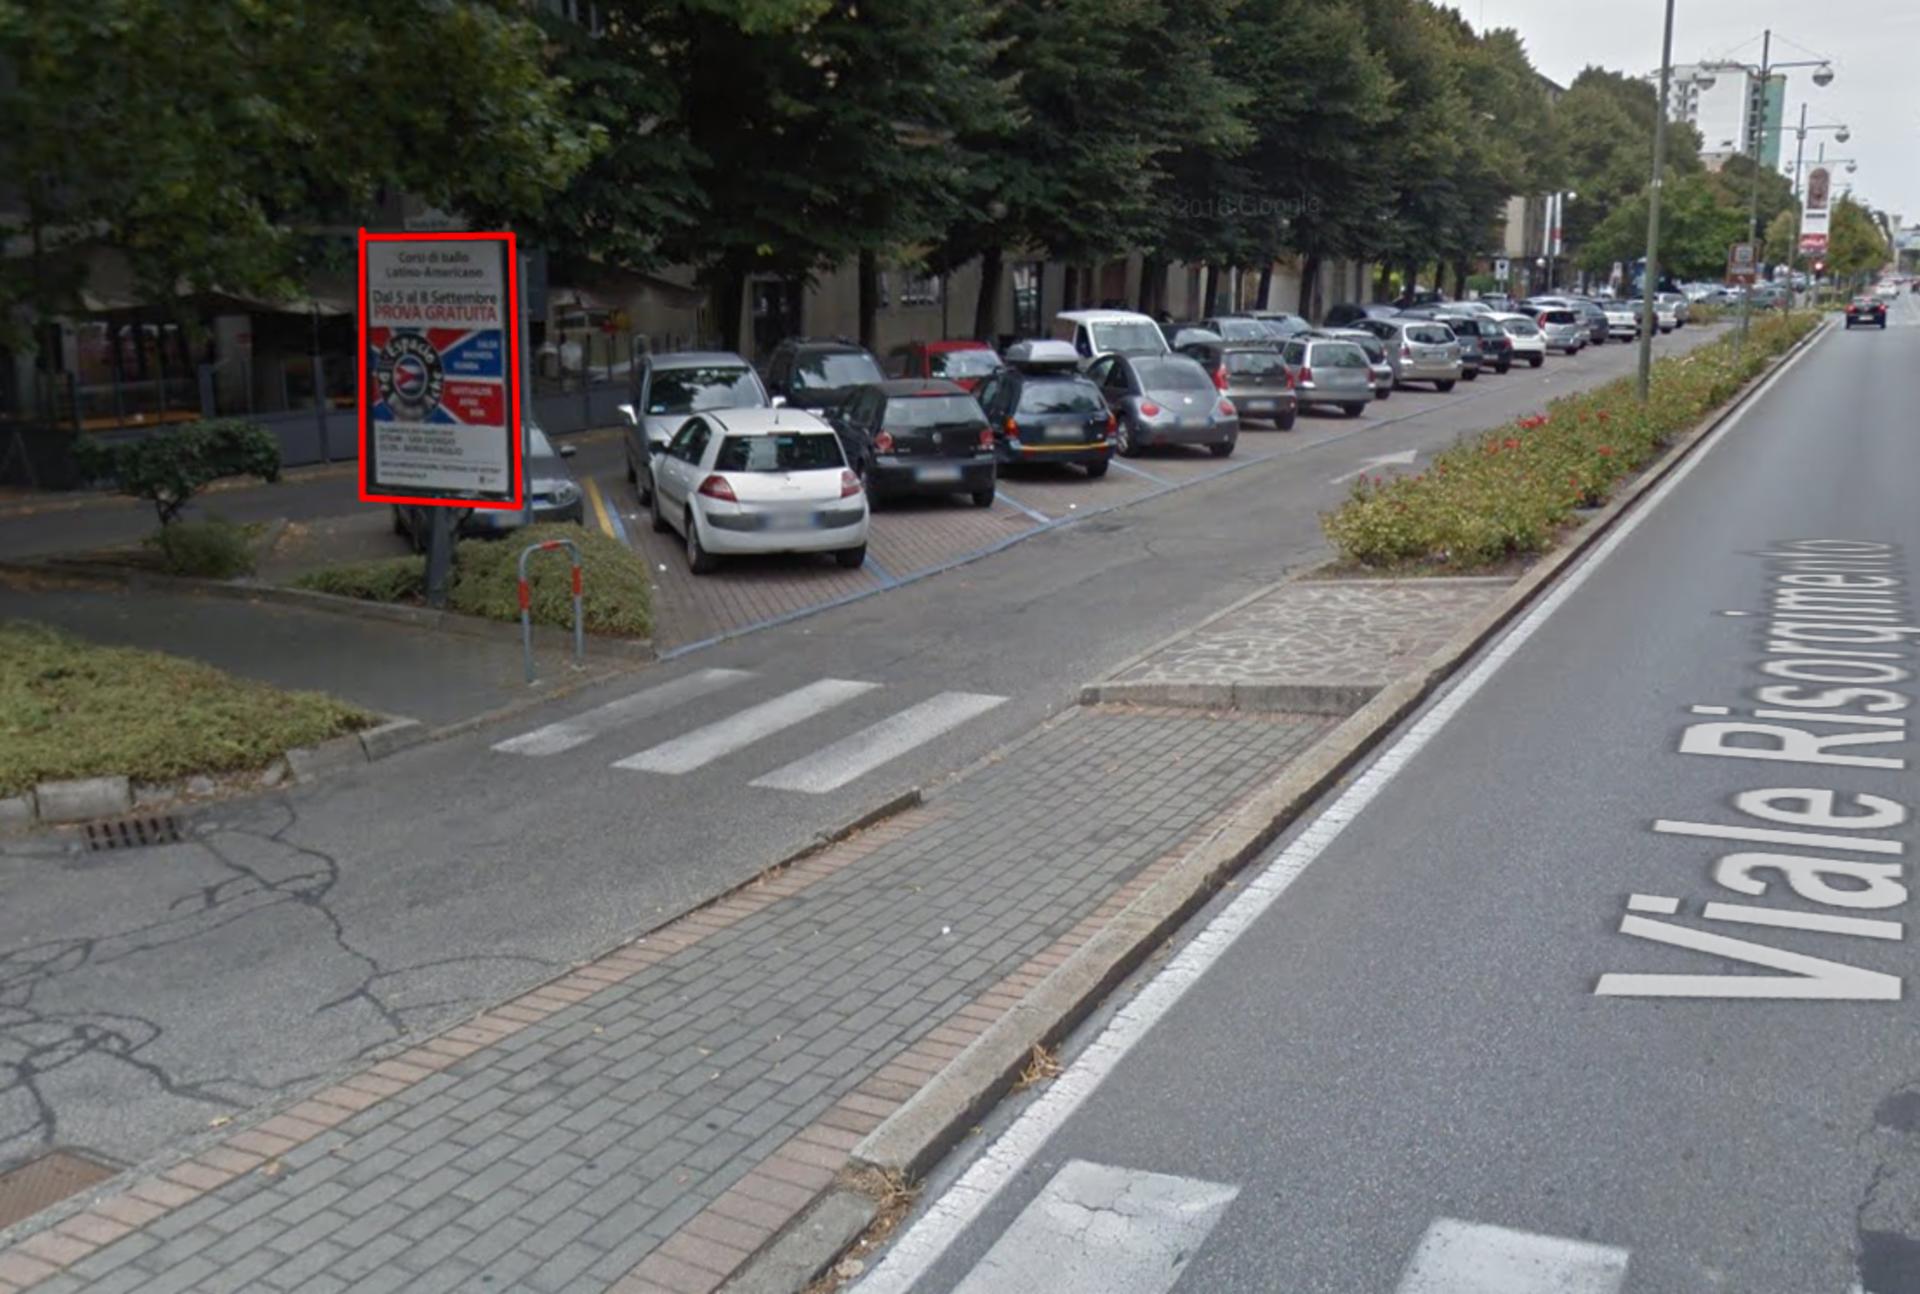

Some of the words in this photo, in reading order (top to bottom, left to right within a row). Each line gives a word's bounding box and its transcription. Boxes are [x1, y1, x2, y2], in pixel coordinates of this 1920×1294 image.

[398, 251, 425, 263] Corsi
[428, 250, 438, 263] di
[441, 250, 470, 263] ballo
[385, 267, 484, 279] Latino-Americano
[372, 289, 394, 304] Dal
[396, 290, 404, 304] 5
[406, 290, 418, 304] al
[420, 290, 429, 304] 8
[430, 290, 498, 305] Settembre
[374, 304, 422, 319] PROVA
[425, 305, 499, 321] GRATUITA
